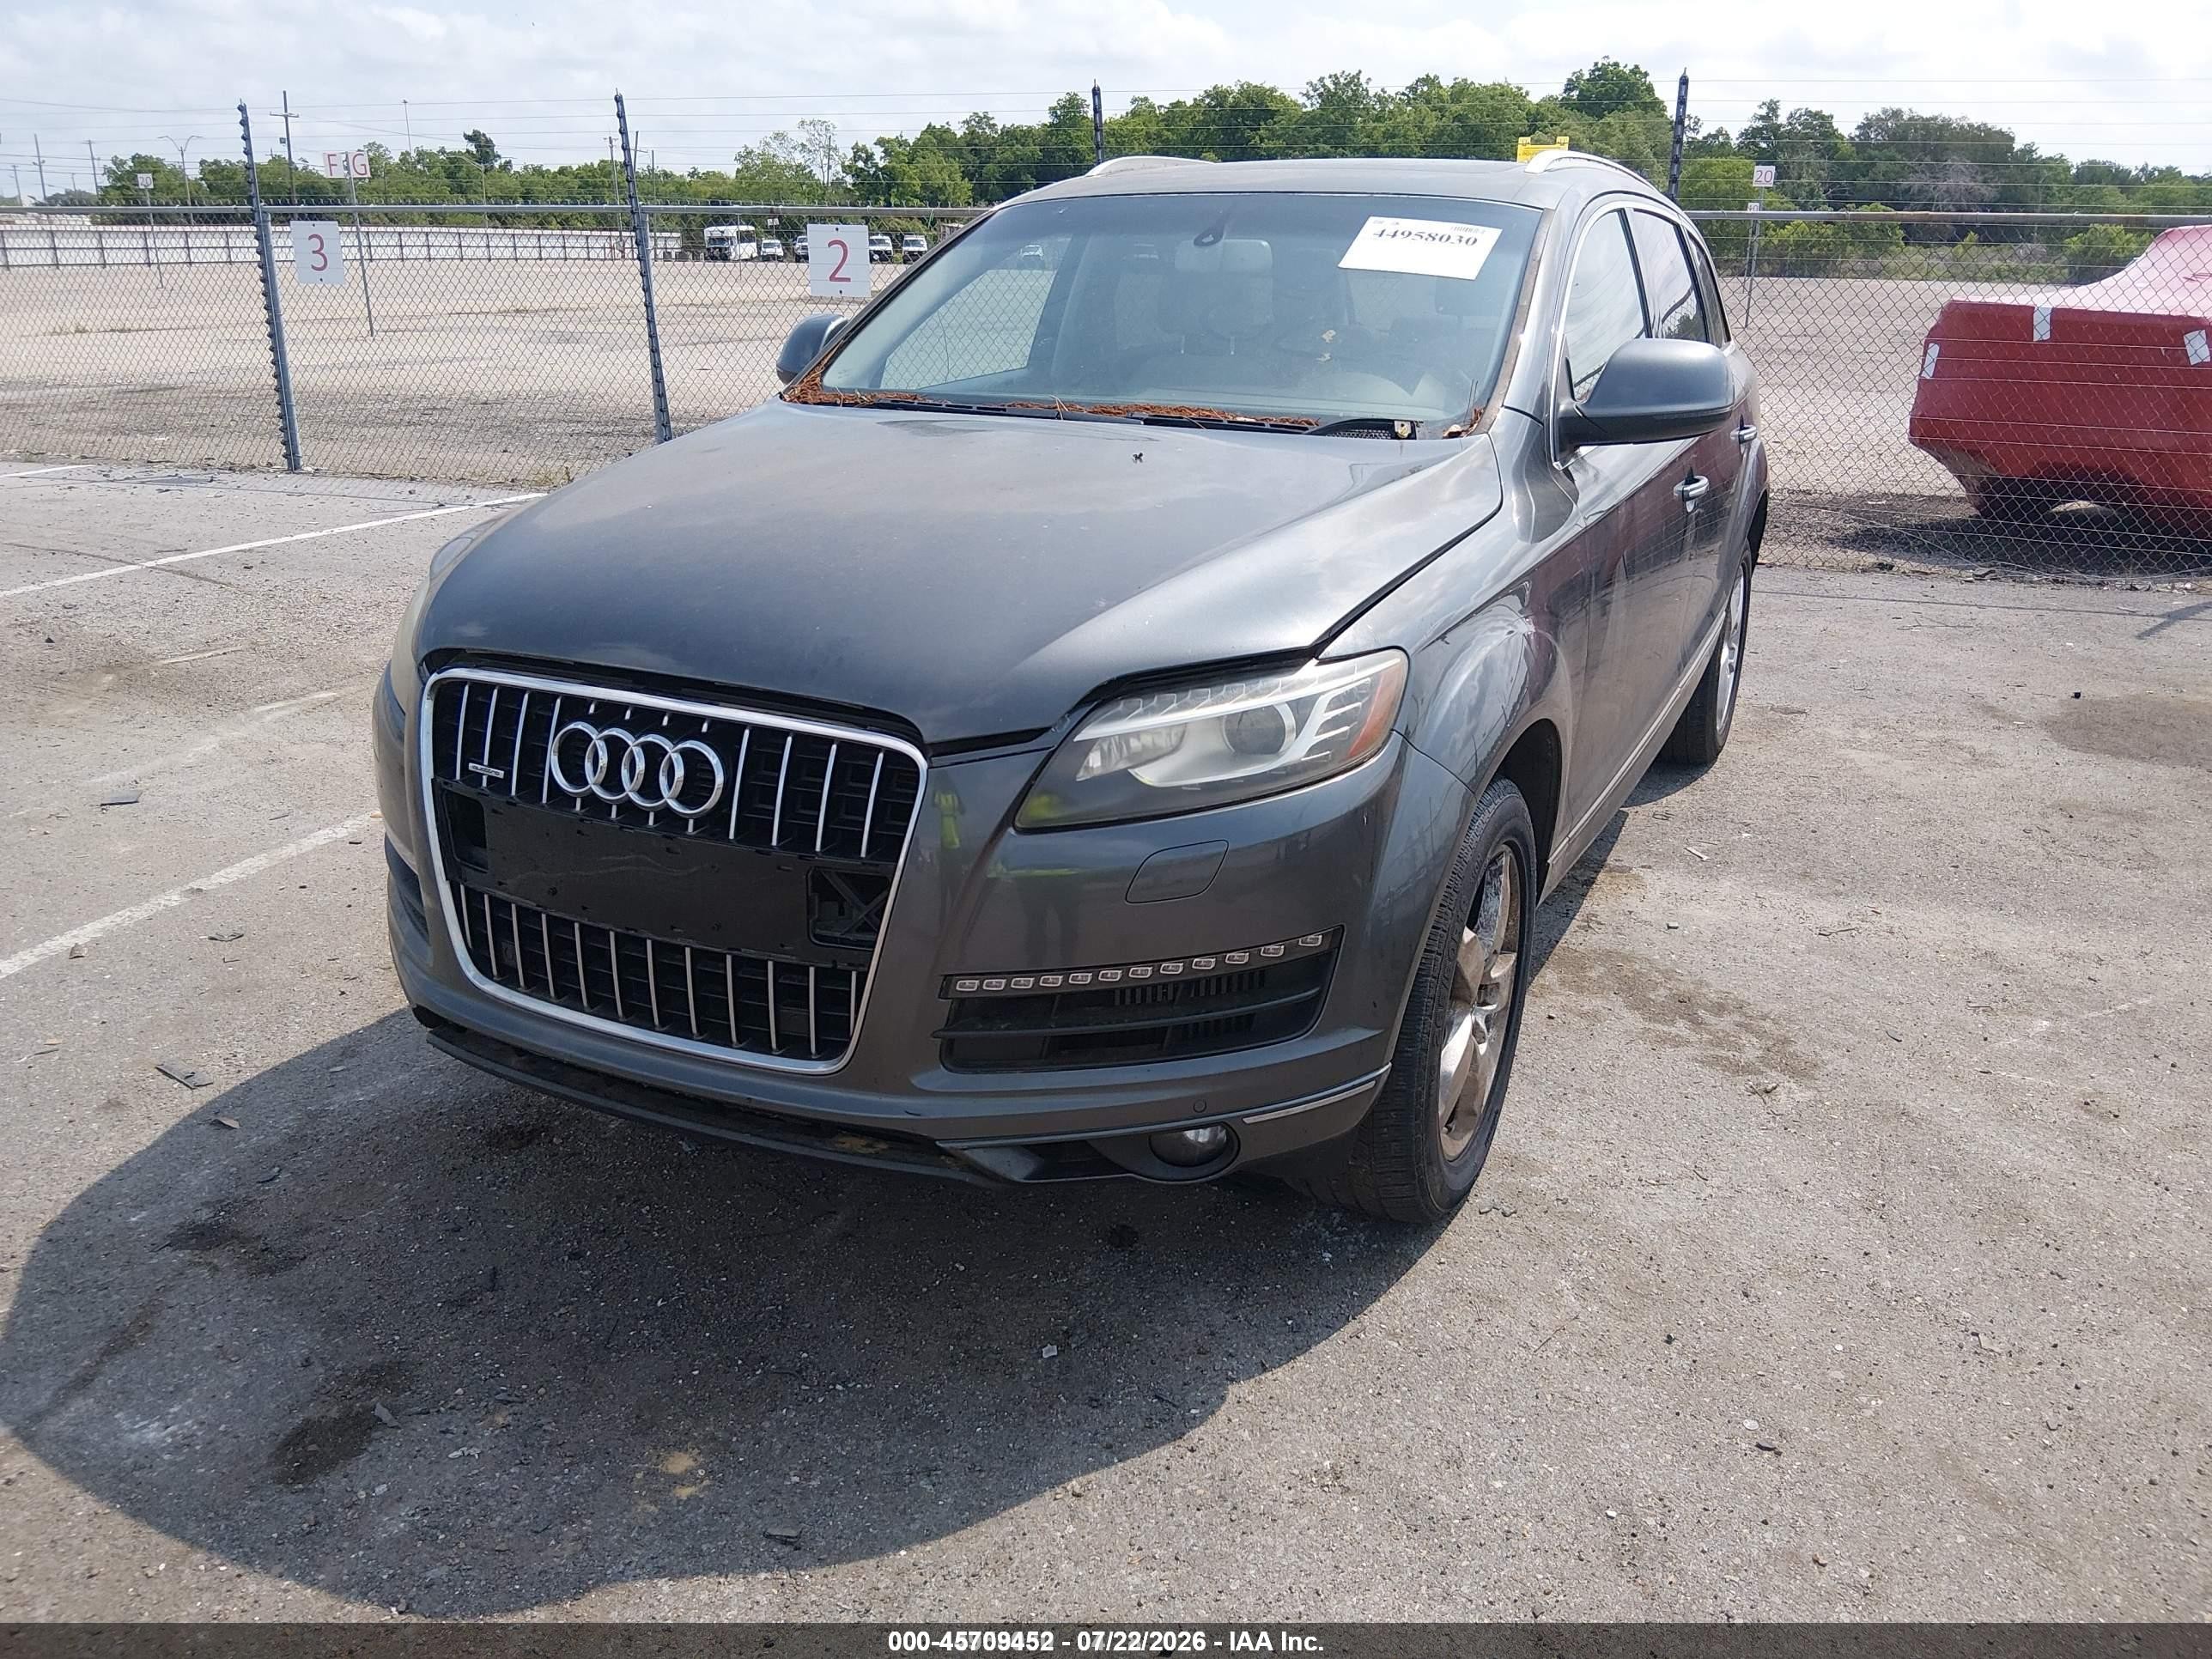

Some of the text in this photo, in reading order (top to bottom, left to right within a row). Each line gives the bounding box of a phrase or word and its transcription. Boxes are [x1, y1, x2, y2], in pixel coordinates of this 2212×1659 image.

[327, 154, 337, 177] F
[352, 153, 368, 176] G
[139, 176, 152, 187] 20
[1754, 170, 1773, 183] 20
[1373, 228, 1478, 246] 44958030
[307, 234, 328, 271] 3
[827, 240, 851, 283] 2
